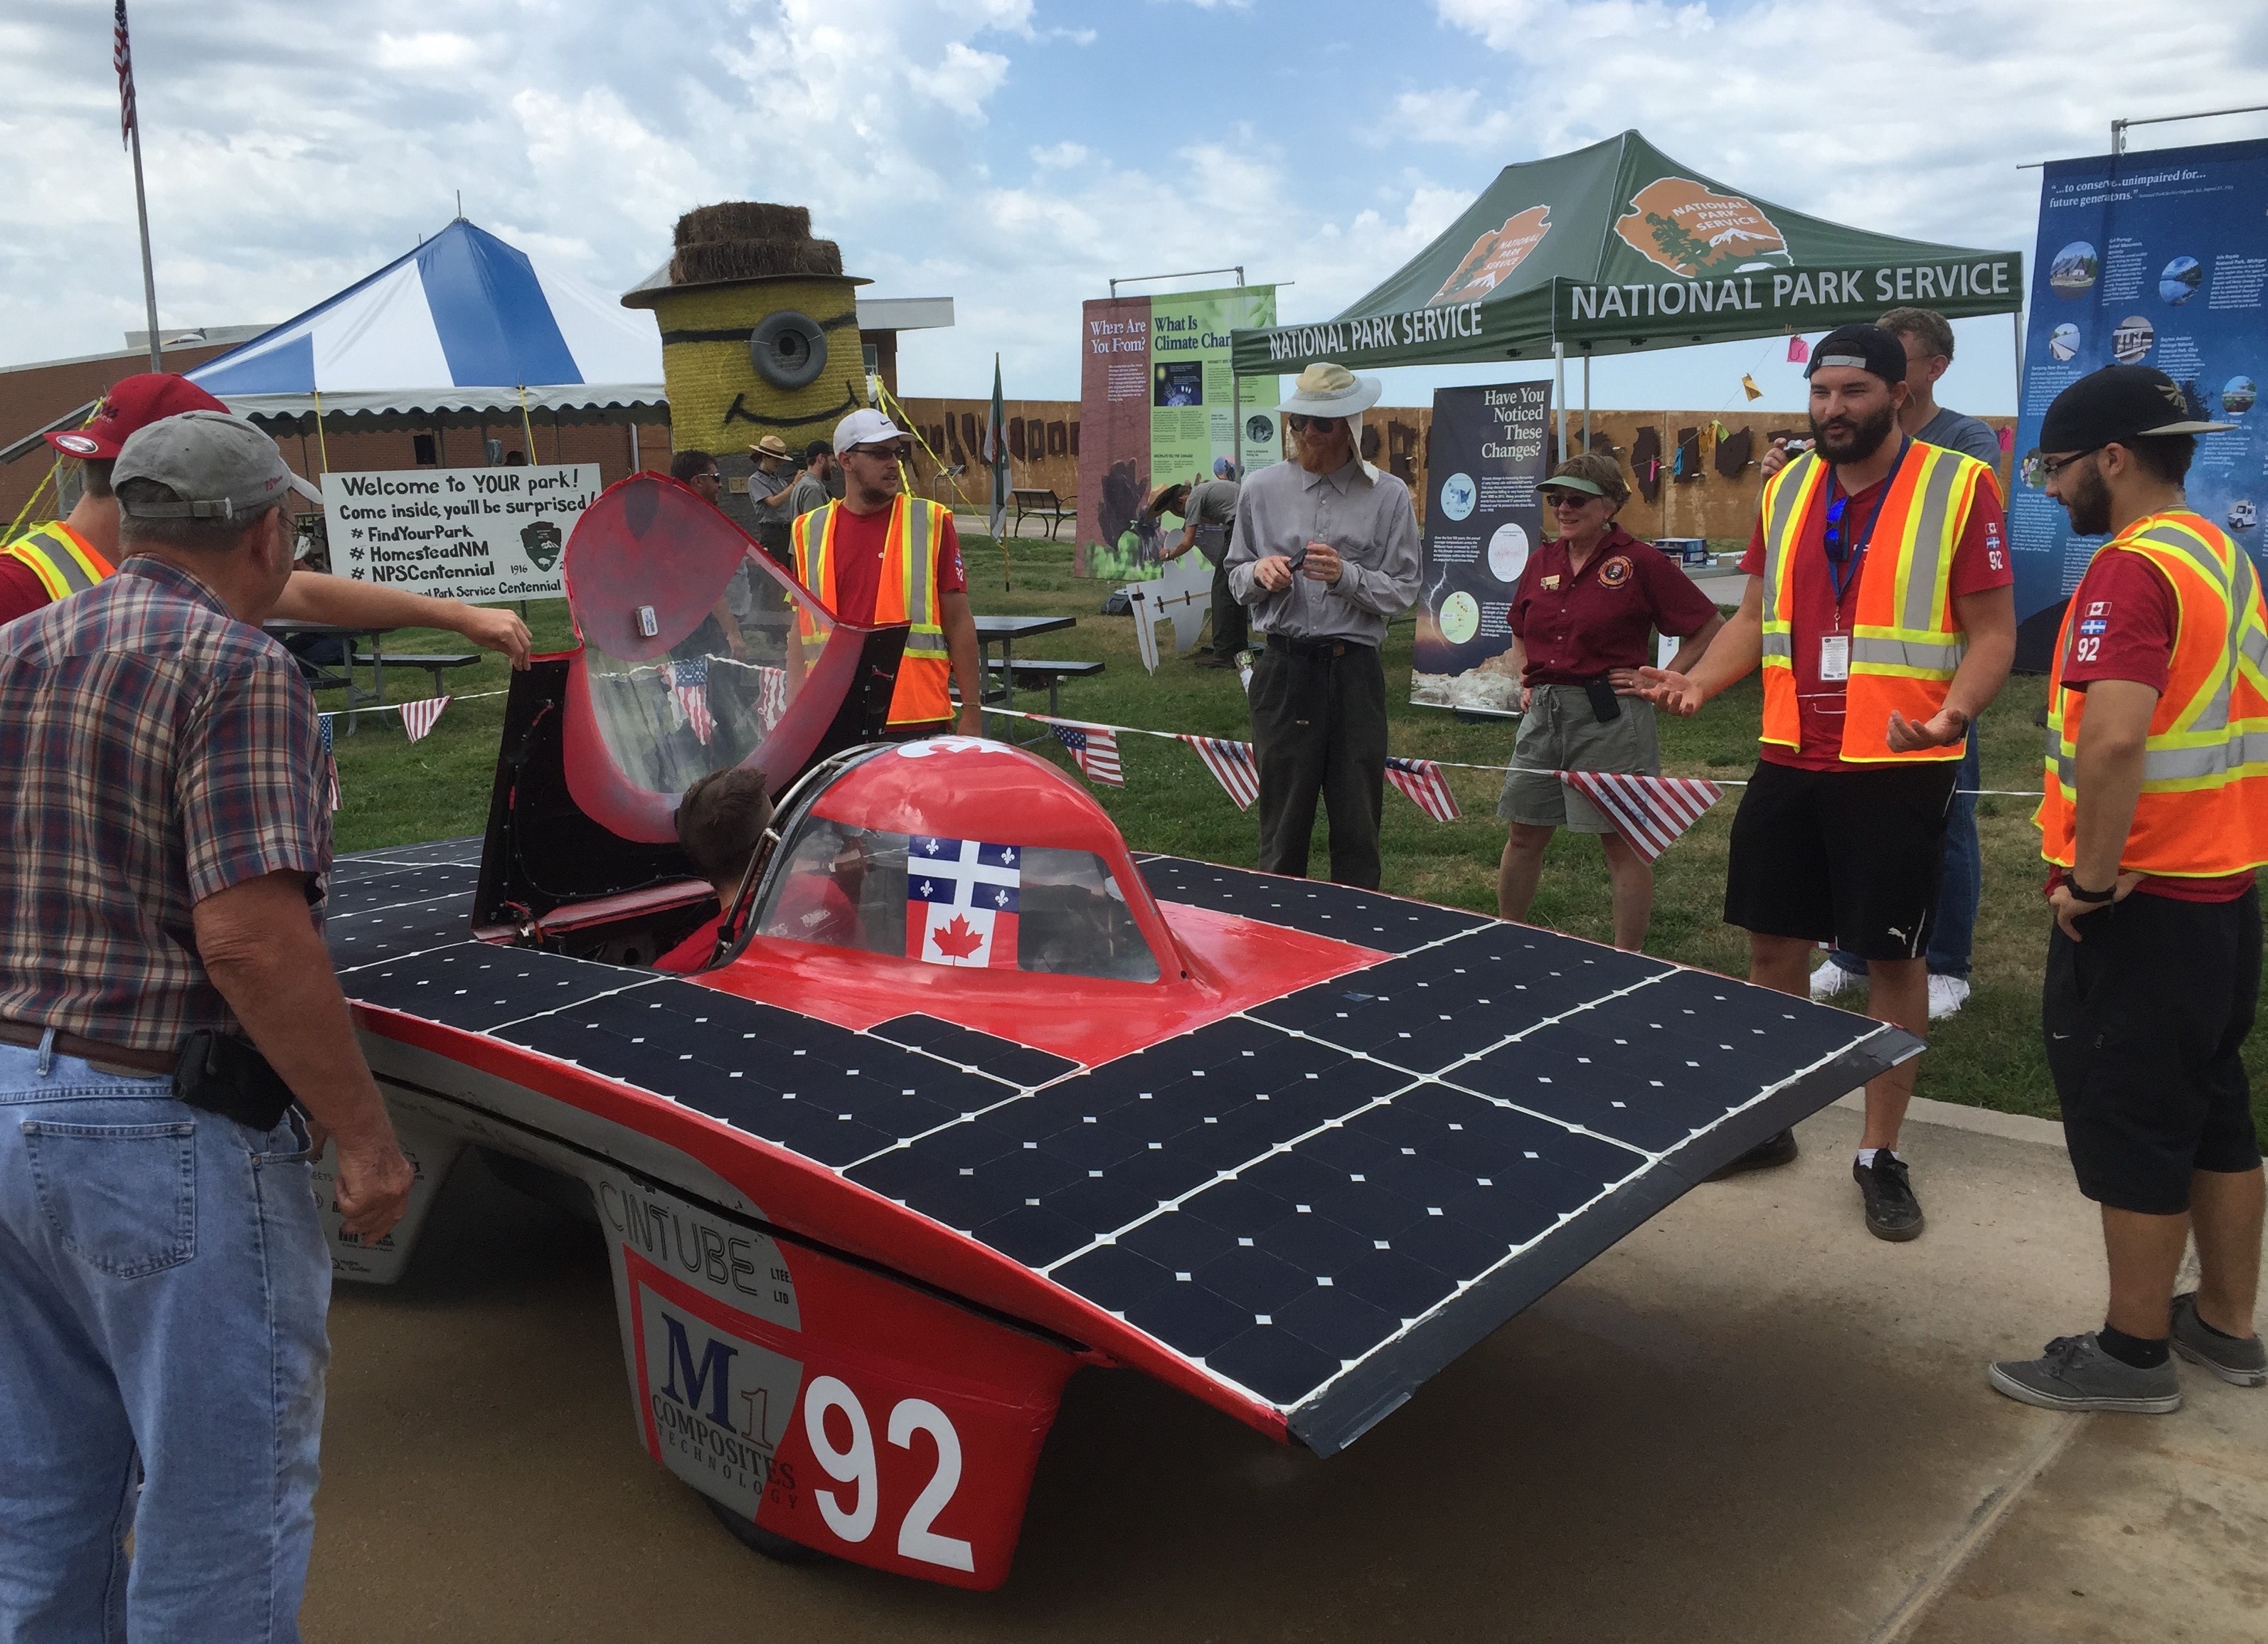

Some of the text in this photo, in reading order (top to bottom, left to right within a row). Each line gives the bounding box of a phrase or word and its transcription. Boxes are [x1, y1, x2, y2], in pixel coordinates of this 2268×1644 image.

[1672, 201, 1748, 217] NATIONAL
[2050, 197, 2079, 208] future
[1695, 216, 1759, 231] SERVICE
[1697, 210, 1739, 220] PARK
[1497, 233, 1540, 250] NATIONAL
[1572, 262, 2010, 319] NATIONAL PARK SERVICE
[1090, 318, 1146, 336] Where Are
[1154, 315, 1198, 332] What Is
[1268, 302, 1483, 361] NATIONAL PARK SERVICE
[1112, 336, 1146, 353] From?
[1154, 335, 1199, 351] Climate
[1484, 387, 1545, 405] Have You
[1494, 403, 1544, 423] Noticed
[1503, 424, 1543, 440] These
[1481, 441, 1541, 462] Changes?
[341, 468, 578, 497] Welcome to YOUR park!
[339, 504, 387, 520] Come
[391, 501, 442, 519] inside,
[442, 499, 480, 520] you'll
[482, 499, 501, 514] be
[351, 524, 474, 542] # FindYourPark
[349, 541, 489, 562] # HomesteadNM
[1989, 550, 2003, 571] 92
[351, 561, 528, 583] # NPSCentennial 1916
[433, 587, 454, 598] Park
[456, 585, 496, 598] Service
[499, 579, 562, 595] Centennial
[2077, 637, 2100, 662] 92
[599, 1180, 758, 1297] CINTUBE
[773, 1290, 789, 1305] LTD
[652, 1394, 797, 1491] COMPOSITES
[657, 1421, 799, 1510] TECHNOLOGY
[804, 1375, 975, 1573] 92
